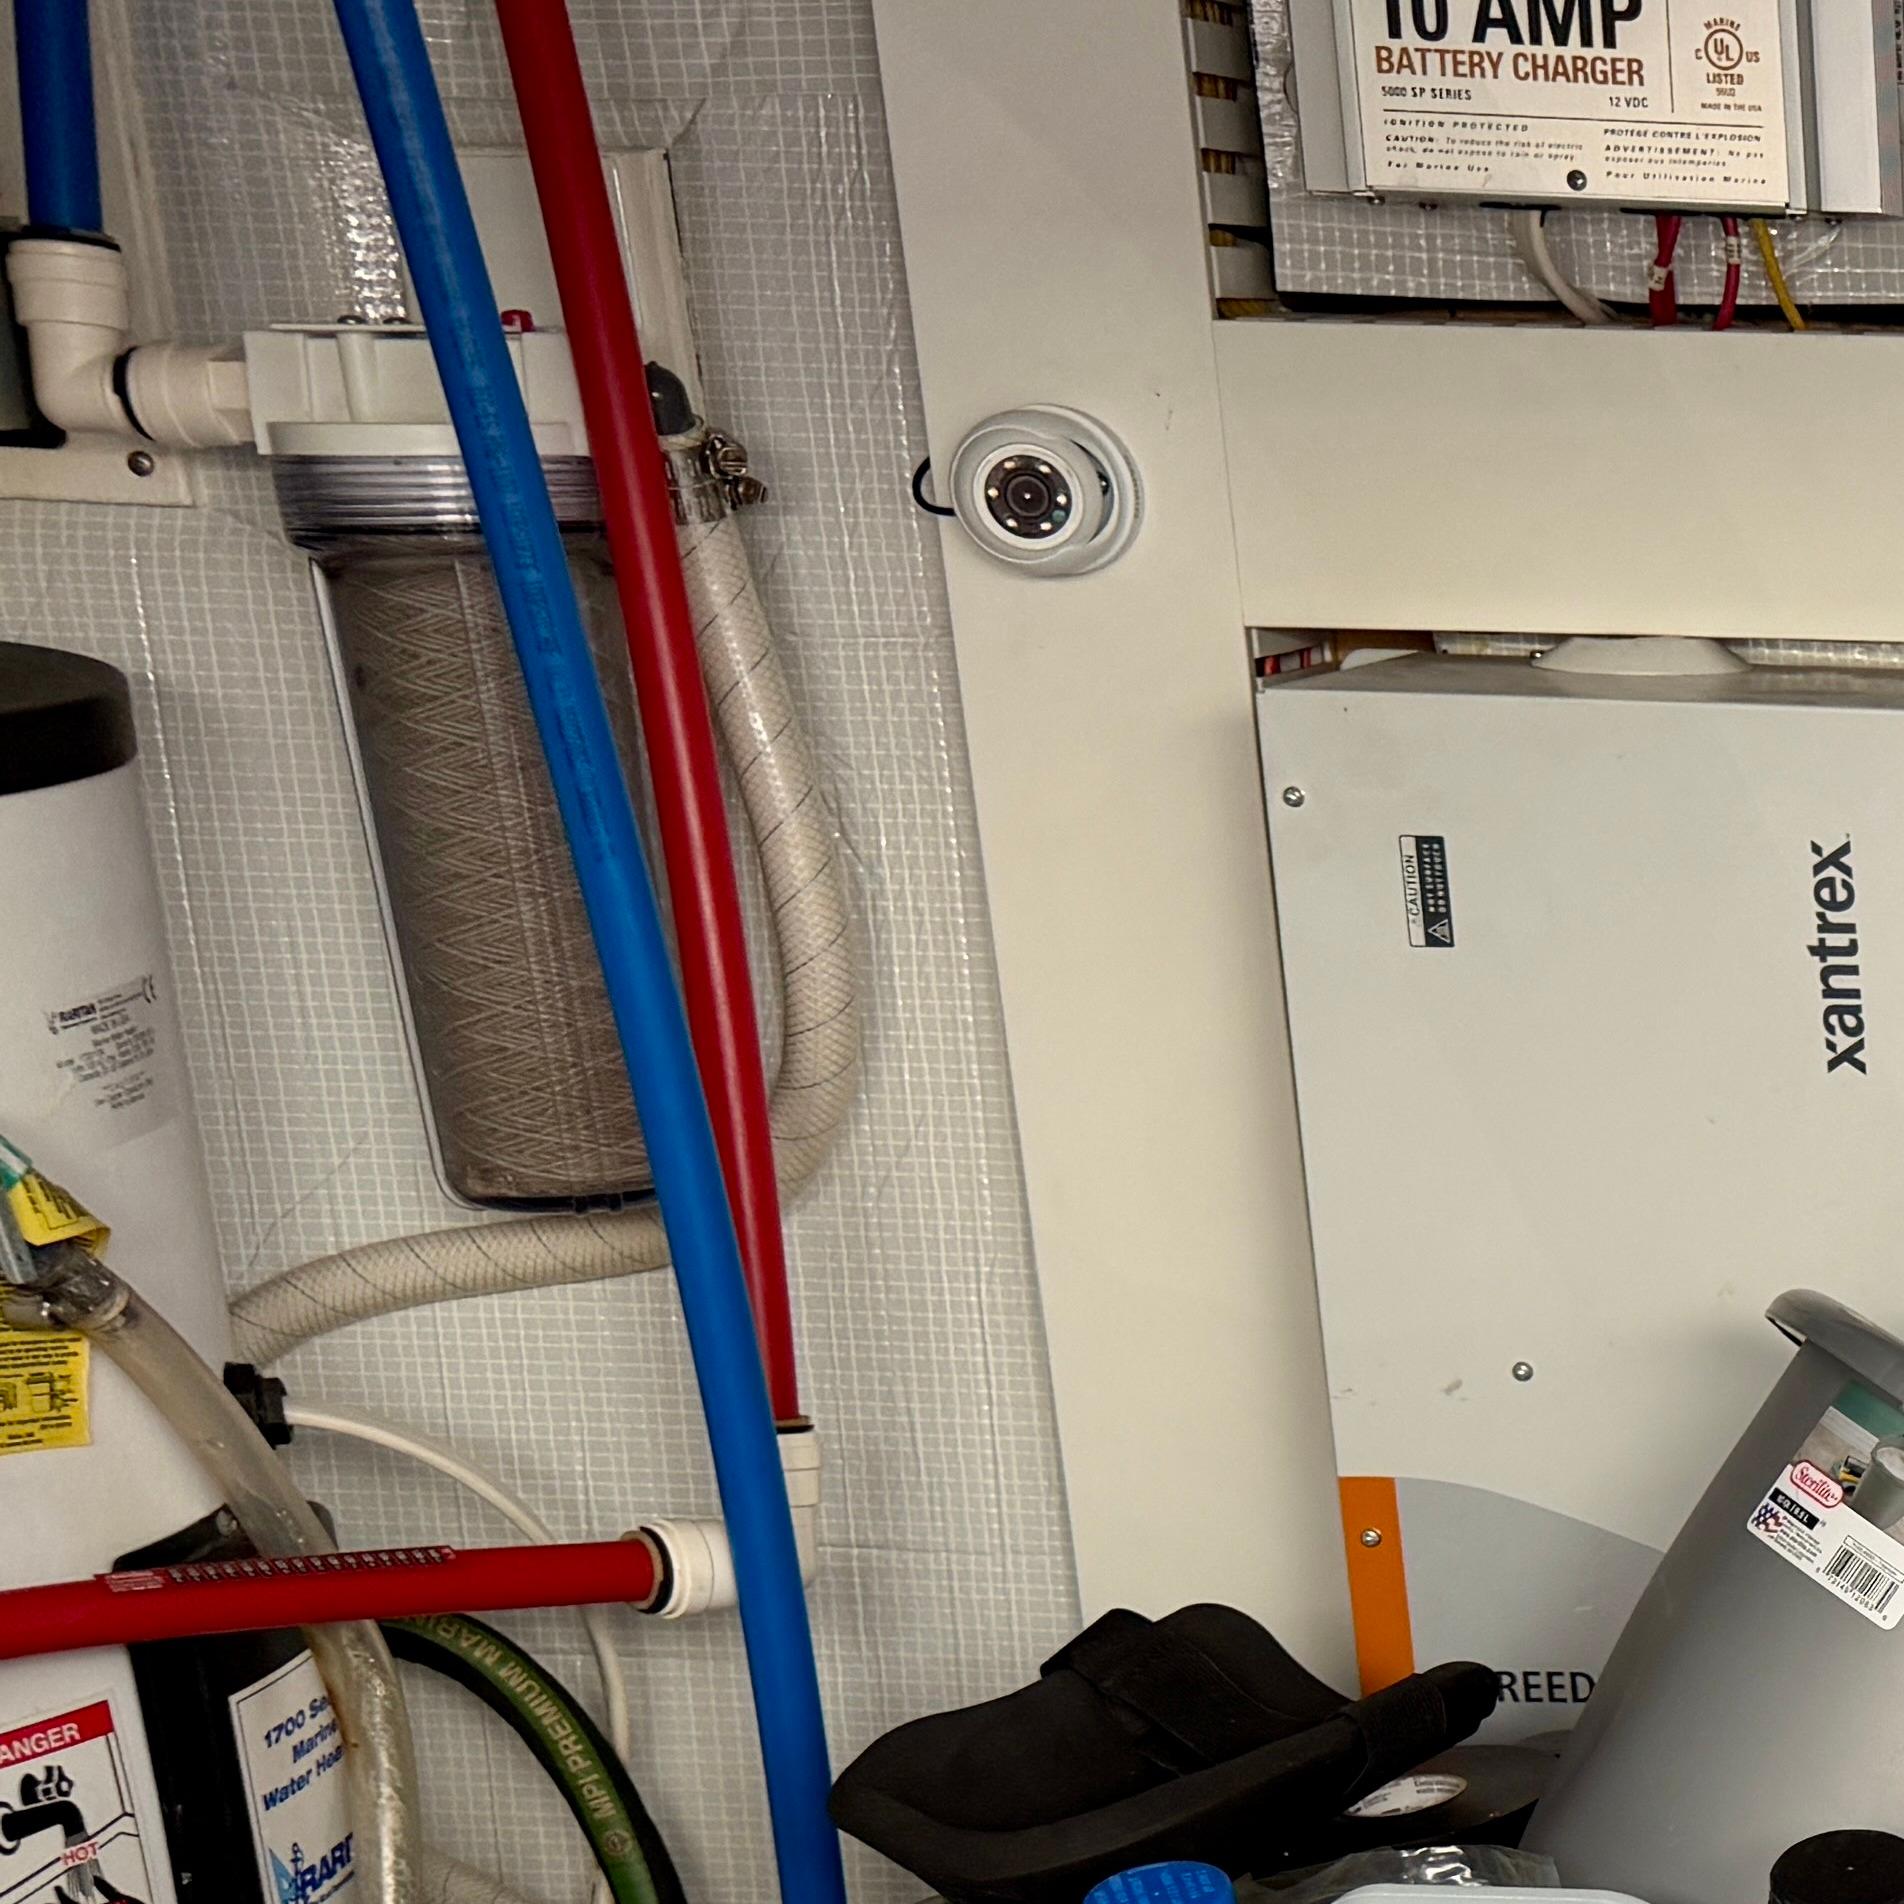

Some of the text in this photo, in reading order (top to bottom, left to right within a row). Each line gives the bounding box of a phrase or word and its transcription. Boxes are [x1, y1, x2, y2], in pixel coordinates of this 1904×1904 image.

[1472, 0, 1643, 49] AMP
[1375, 46, 1645, 86] BATTERY CHARGER
[1706, 73, 1744, 85] LISTED
[1431, 87, 1472, 100] SERIES
[1609, 97, 1648, 108] 12 VDC
[1402, 855, 1420, 916] CAUTION
[1808, 833, 1870, 1077] xantrex
[1496, 1669, 1597, 1705] REED
[263, 1709, 306, 1750] 1700
[499, 1662, 593, 1777] PREMIUM
[0, 1722, 81, 1767] ANGER
[263, 1767, 313, 1812] Water
[62, 1841, 98, 1866] HOT
